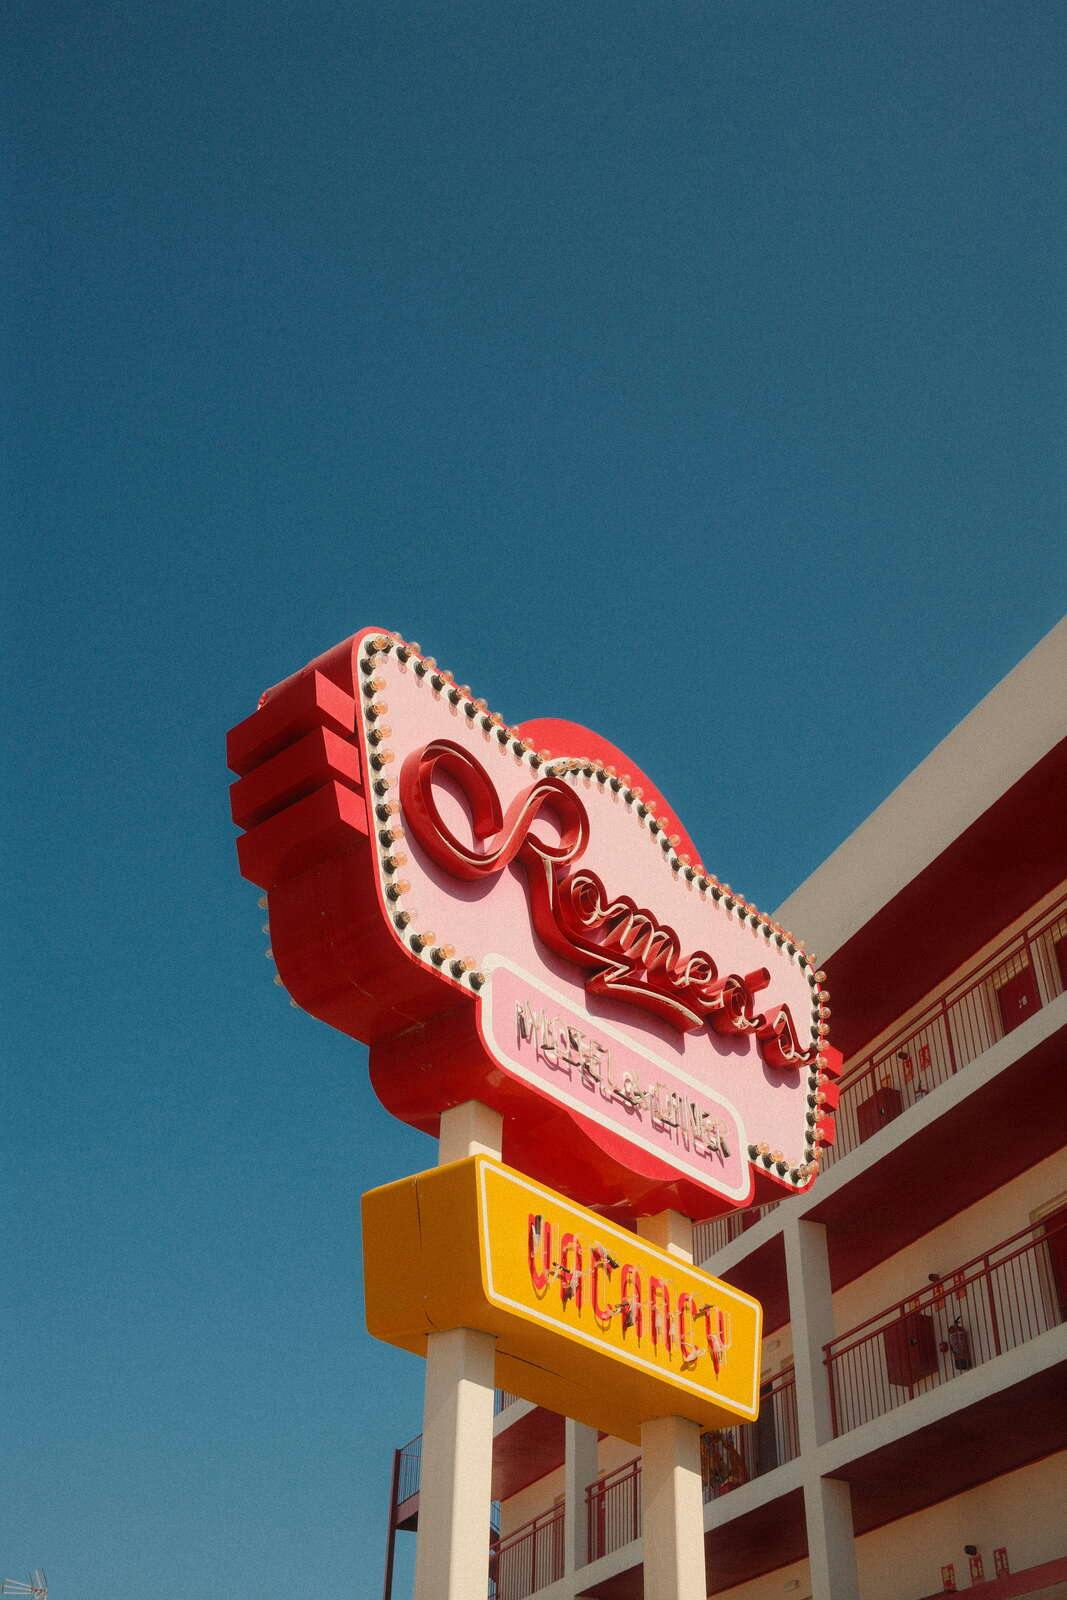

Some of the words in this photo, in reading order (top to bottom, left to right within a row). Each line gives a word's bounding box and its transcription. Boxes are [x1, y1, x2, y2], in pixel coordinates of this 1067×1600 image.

[515, 999, 615, 1096] MOTEL
[650, 1082, 731, 1163] DINER
[527, 1212, 735, 1379] VACANCY
